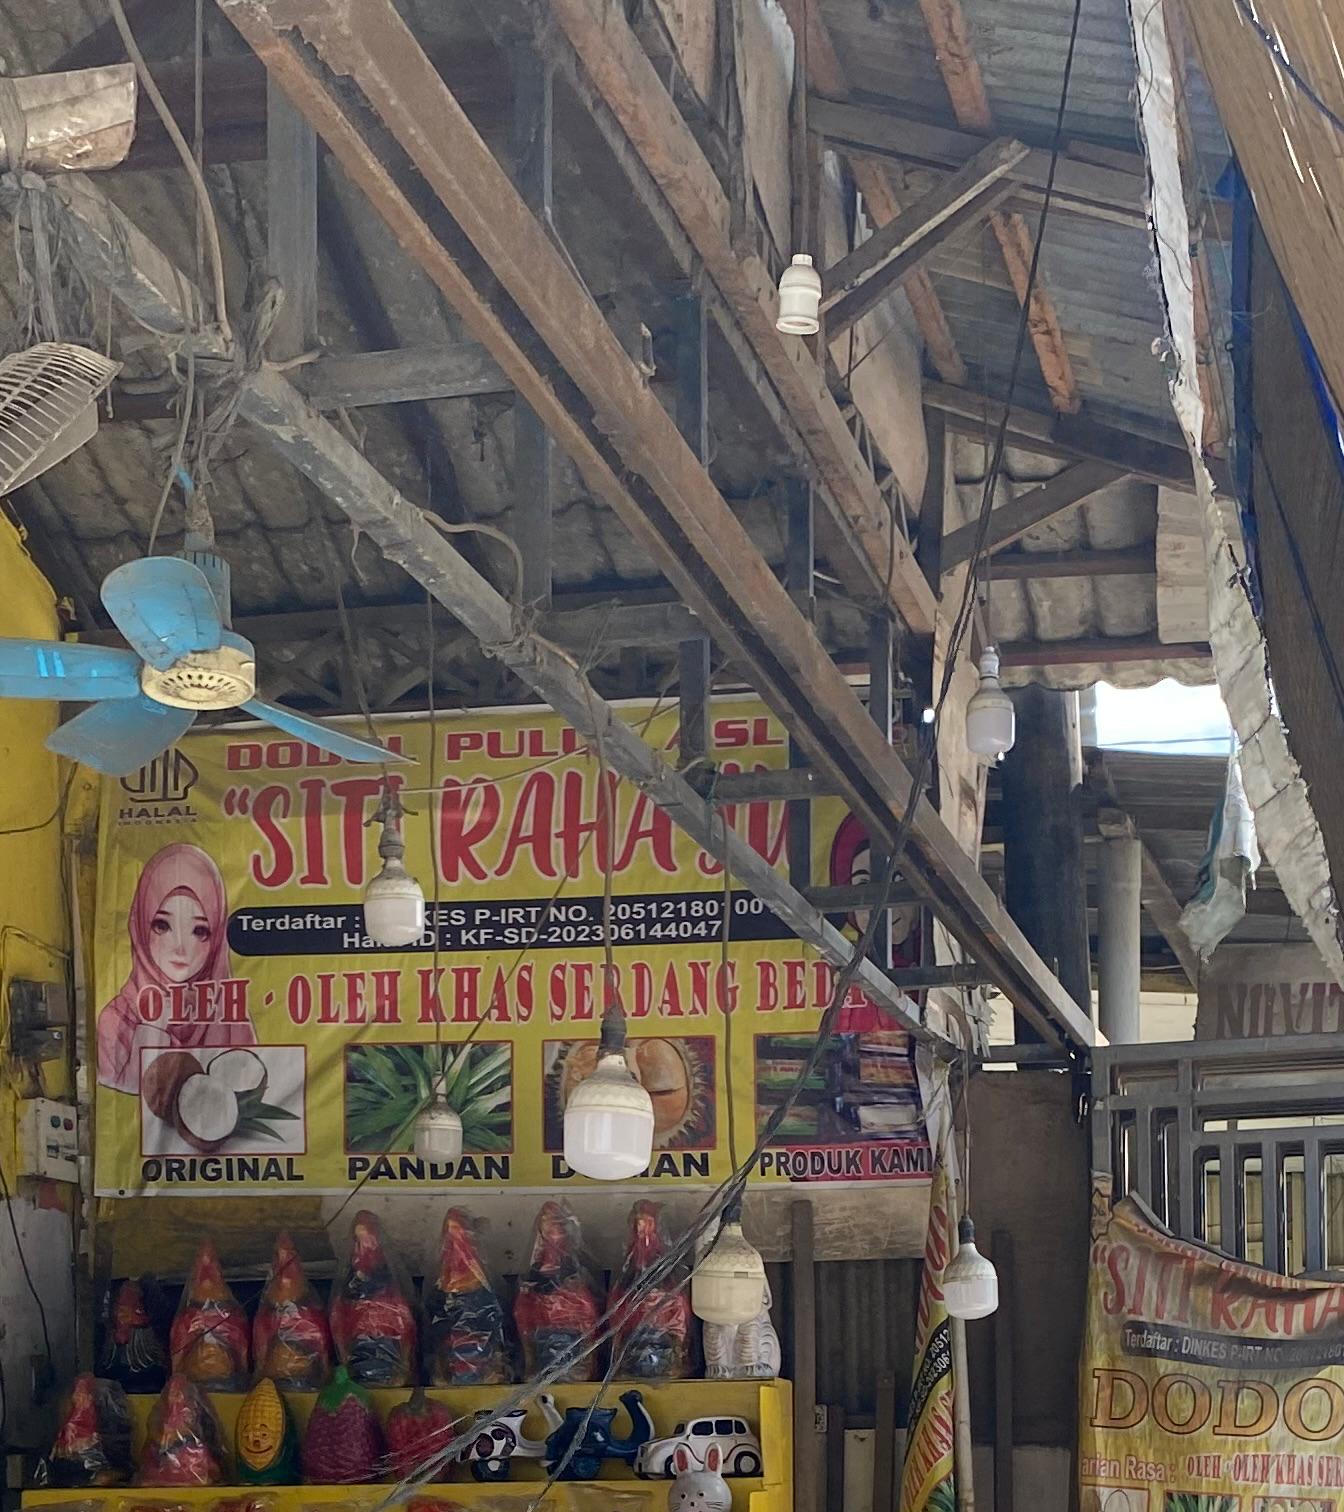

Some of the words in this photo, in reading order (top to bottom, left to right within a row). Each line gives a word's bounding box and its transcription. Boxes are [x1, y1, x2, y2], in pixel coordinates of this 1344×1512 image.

[119, 804, 198, 820] HALAL
[238, 914, 346, 932] Terdaftar
[474, 906, 541, 925] P-IRT
[550, 906, 594, 924] NO.
[138, 979, 250, 1024] OLEH
[288, 970, 401, 1025] OLEH
[417, 963, 535, 1024] KHAS
[550, 960, 739, 1022] SERDANG
[141, 1157, 304, 1183] ORIGINAL
[347, 1155, 510, 1182] PANDAN
[760, 1149, 866, 1178] PRODUK
[1081, 1456, 1121, 1480] arian
